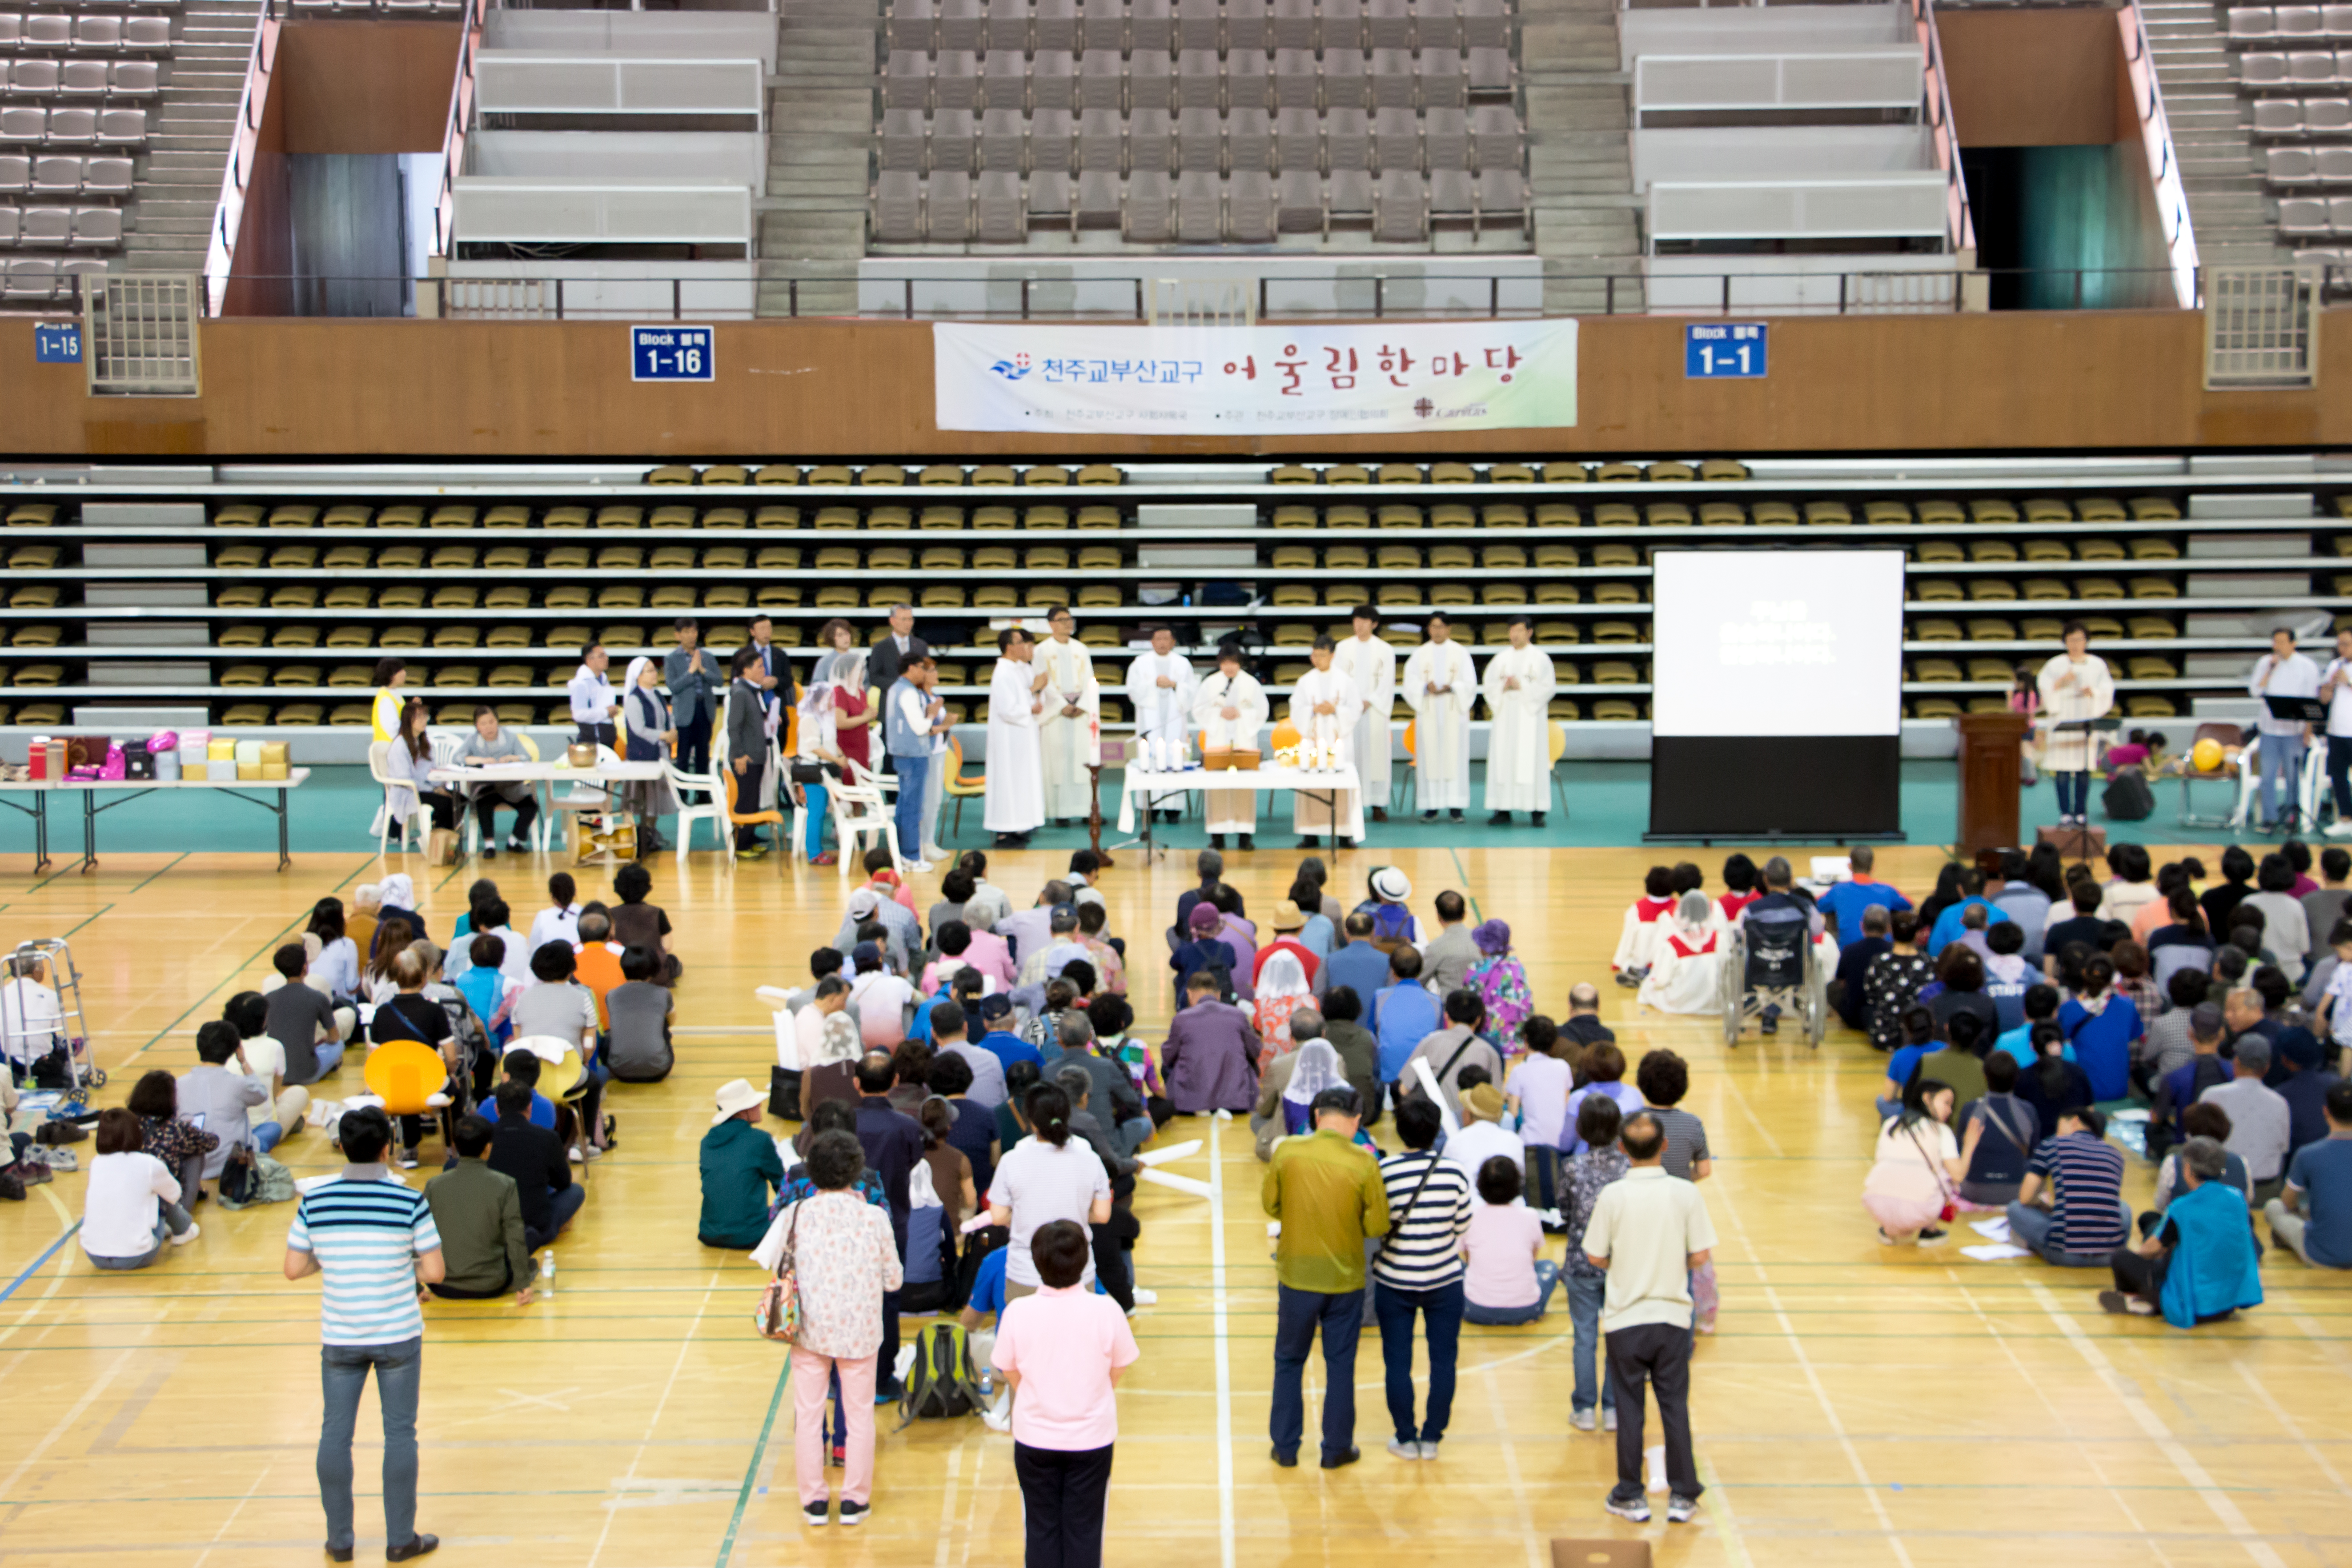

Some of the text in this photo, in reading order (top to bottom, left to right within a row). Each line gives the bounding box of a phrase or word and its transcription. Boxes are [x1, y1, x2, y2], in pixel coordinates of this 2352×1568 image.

[41, 336, 78, 356] 1-15
[639, 333, 675, 345] Block
[647, 349, 702, 374] 1-16
[1041, 358, 1203, 383] 천주교부산교구
[1699, 345, 1750, 374] 1-1
